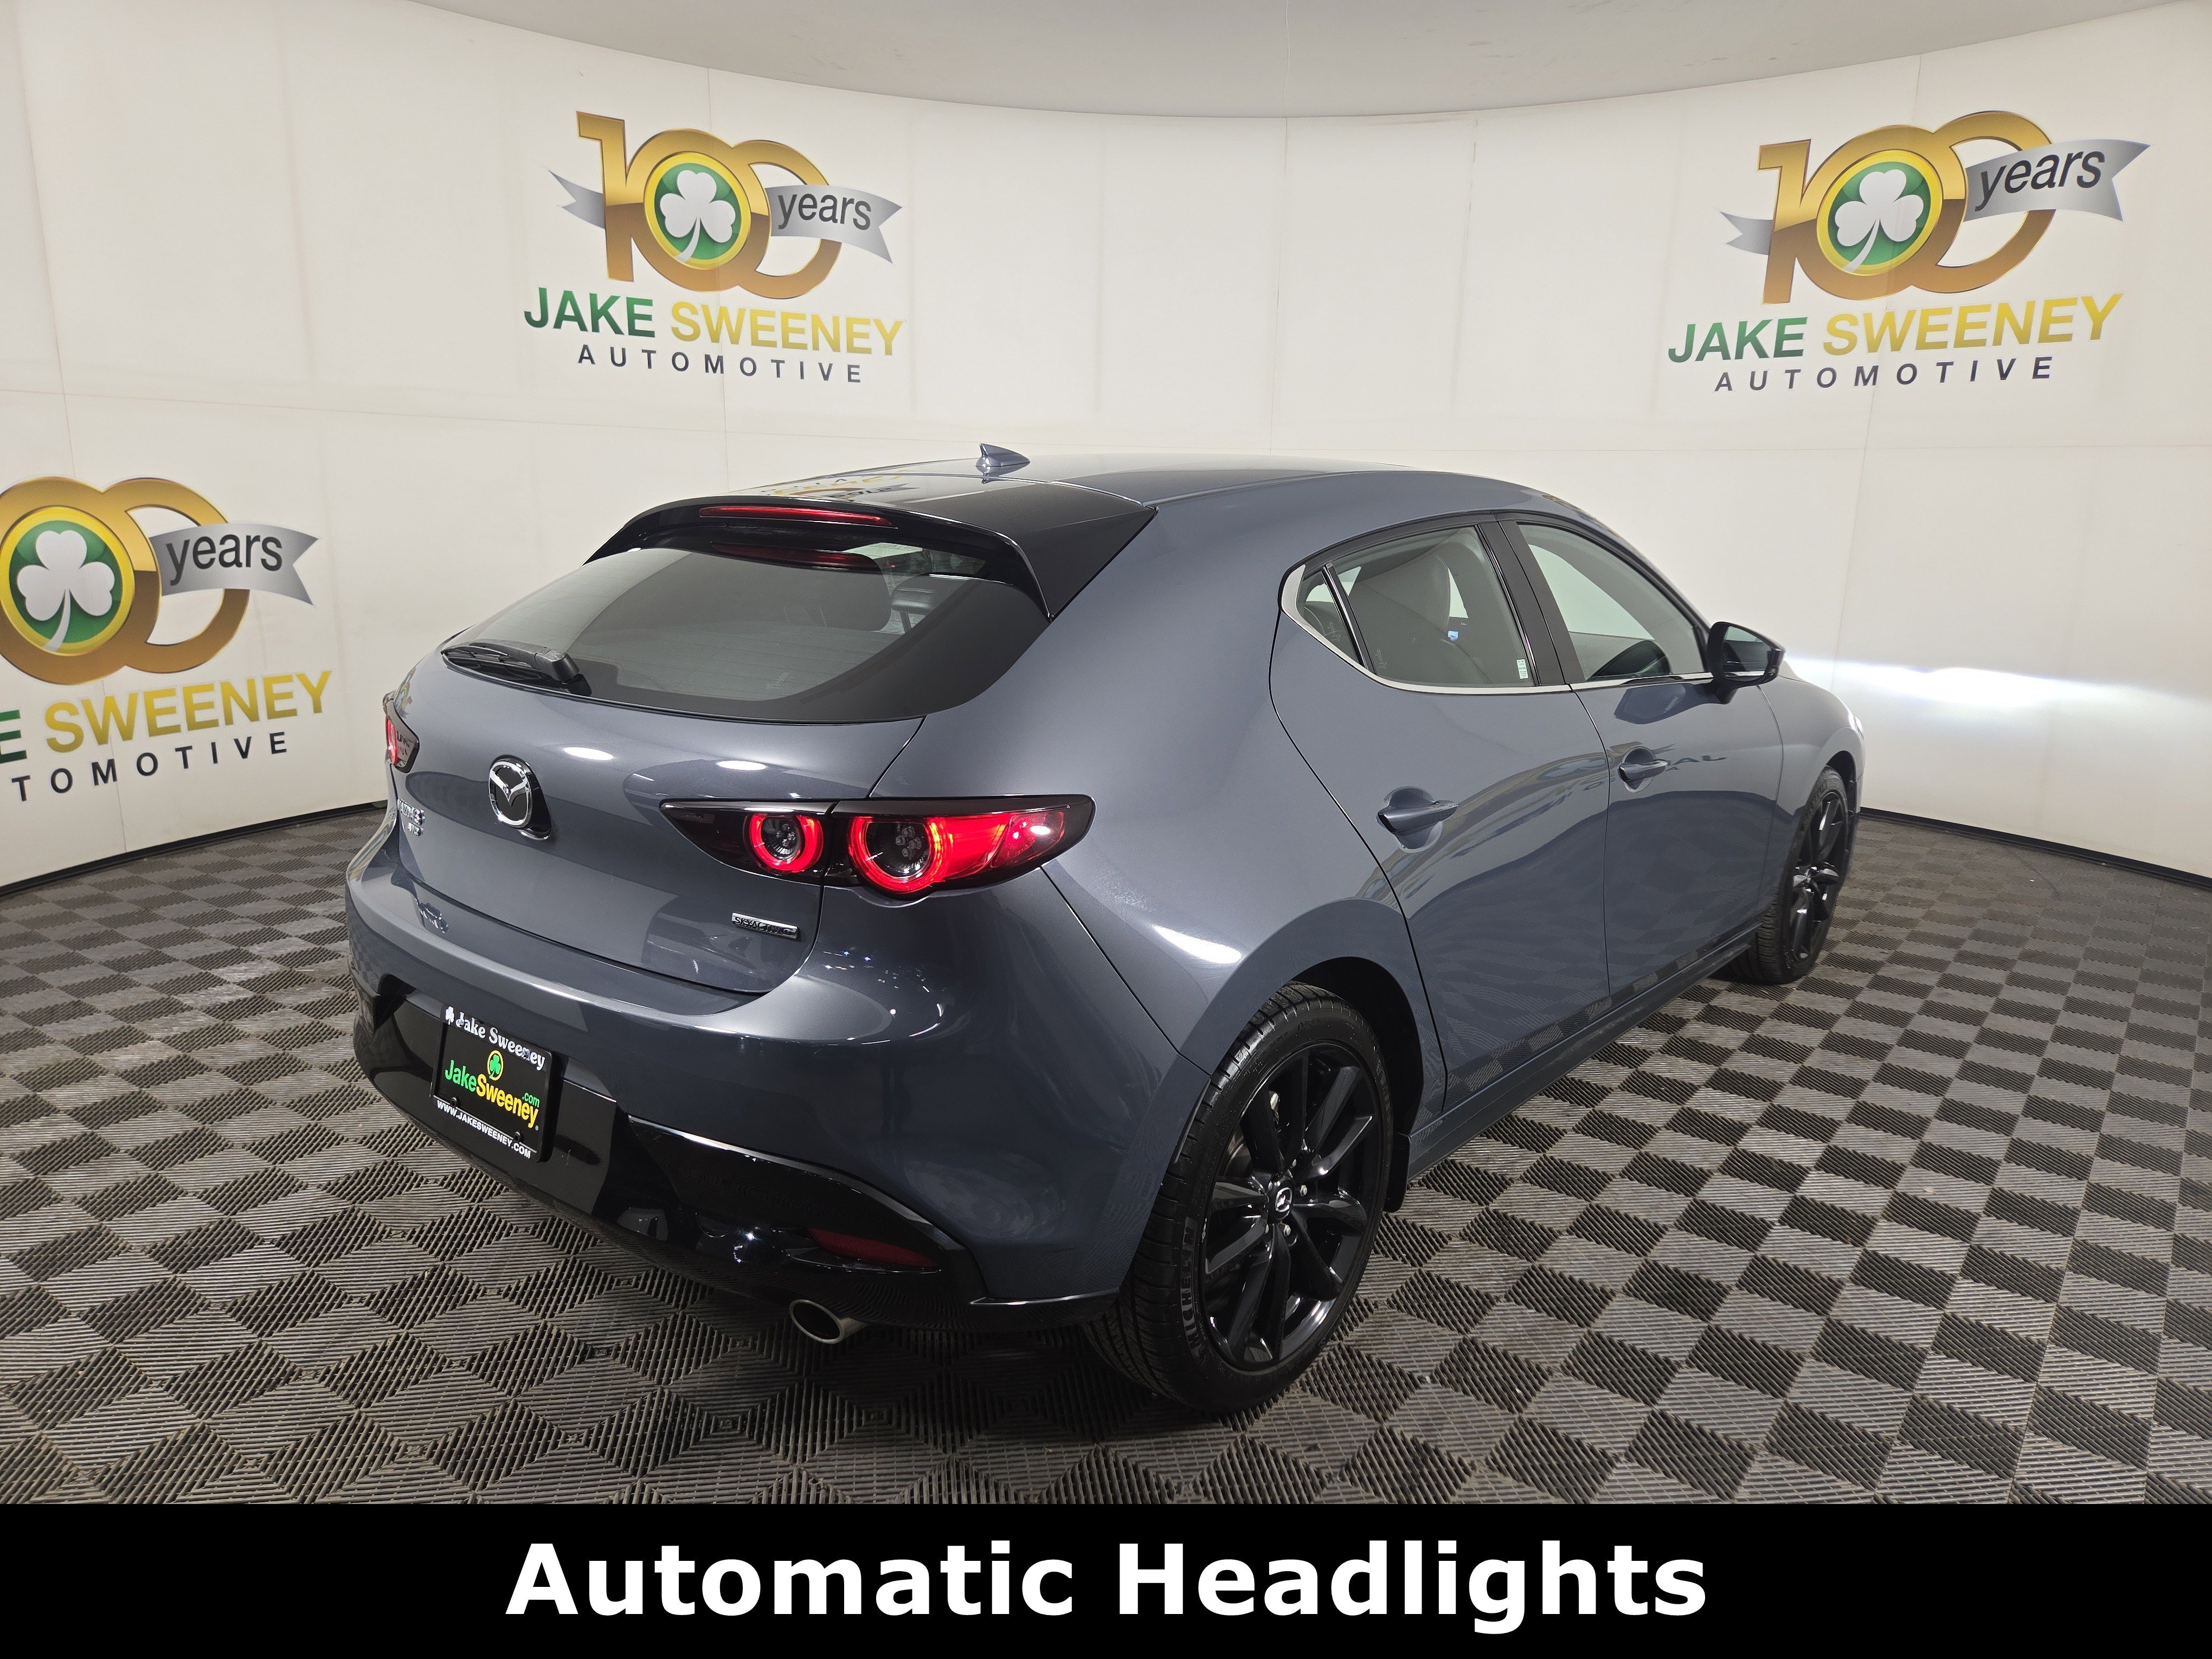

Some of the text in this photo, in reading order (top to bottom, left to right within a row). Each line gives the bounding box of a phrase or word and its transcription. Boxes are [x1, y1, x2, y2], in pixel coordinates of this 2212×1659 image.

[1975, 150, 2105, 211] years
[777, 193, 871, 230] years
[524, 287, 904, 356] JAKE SWEENEY
[1668, 293, 2124, 363] JAKE SWEENEY
[577, 344, 861, 383] AUTOMOTIVE
[1714, 356, 2052, 393] AUTOMOTIVE
[166, 533, 283, 586] years
[44, 671, 332, 754] SWEENEY
[11, 731, 287, 802] TOMOTIVE
[455, 1012, 545, 1071] Jake Sweeney
[436, 1099, 532, 1159] WWW.JAKESWEENEY.COM
[522, 1092, 540, 1108] .com
[1180, 1225, 1202, 1351] MICHELIN
